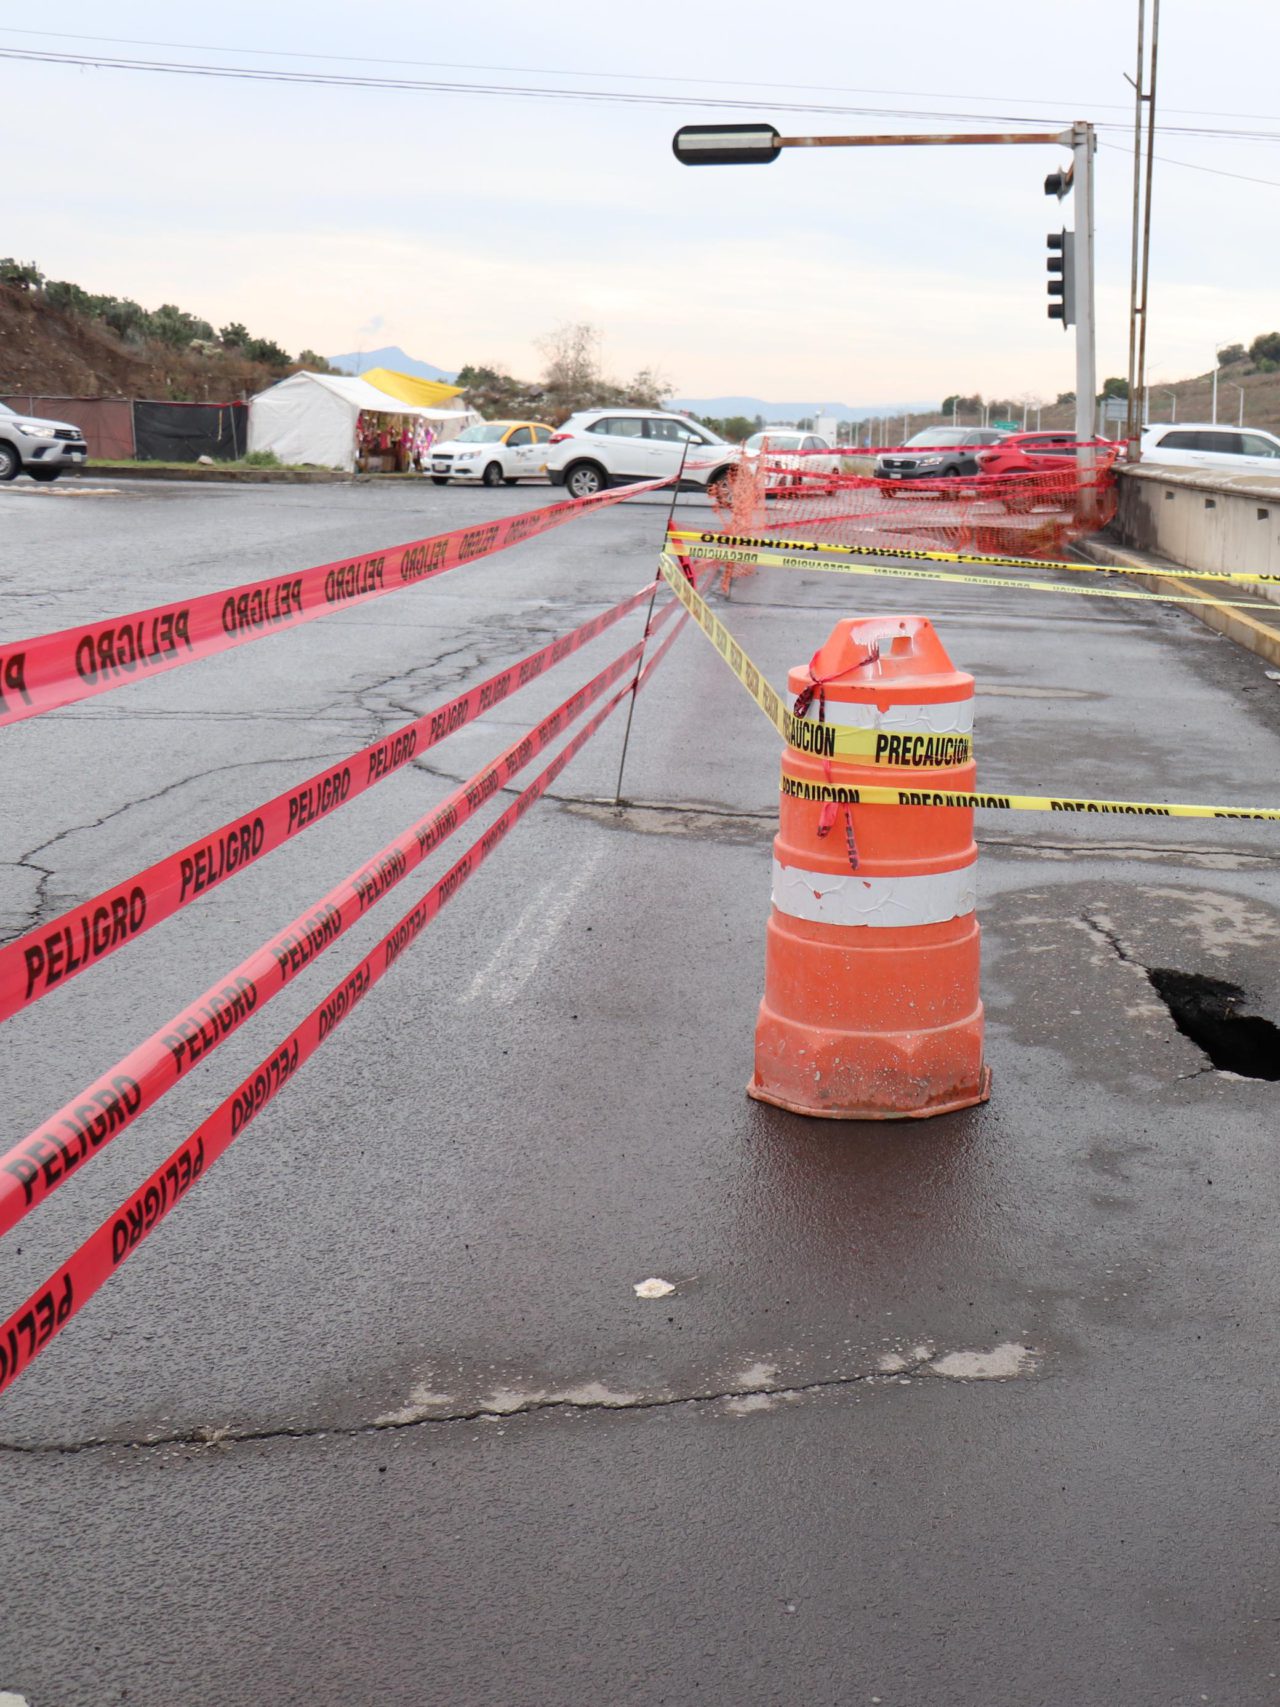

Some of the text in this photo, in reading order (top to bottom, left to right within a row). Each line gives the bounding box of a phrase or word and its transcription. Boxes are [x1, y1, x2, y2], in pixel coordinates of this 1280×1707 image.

[875, 734, 969, 766] PRECAUCION
[24, 886, 147, 1000] PELIGRO
[179, 817, 265, 902] PELIGRO
[287, 767, 351, 834] PELIGRO
[366, 729, 417, 784] PELIGRO
[428, 699, 468, 745] PELIGRO
[3, 1075, 142, 1206] PELIGRO
[161, 976, 257, 1074] PELIGRO
[271, 902, 342, 981] PELIGRO
[352, 847, 407, 911] PELIGRO
[415, 803, 458, 857] PELIGRO
[318, 963, 370, 1041] PELIGRO
[231, 1039, 299, 1136] PELIGRO
[112, 1137, 205, 1265] PELIGRO
